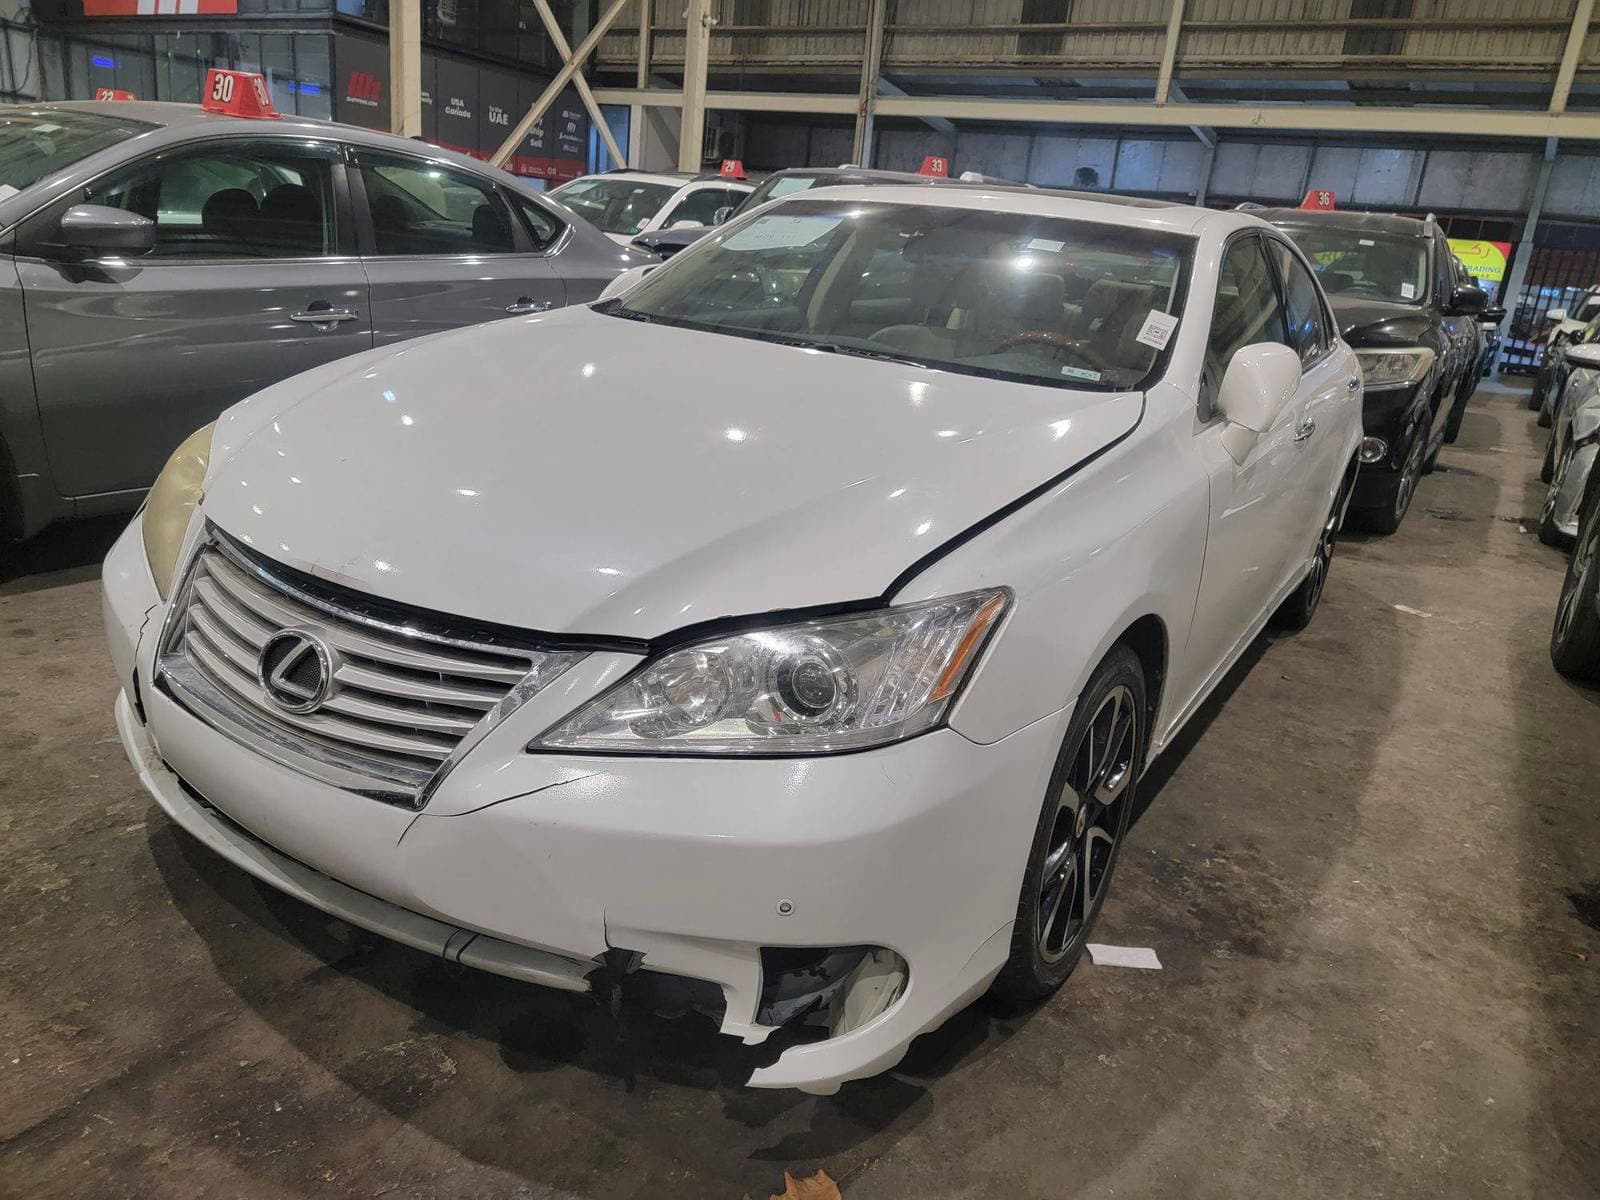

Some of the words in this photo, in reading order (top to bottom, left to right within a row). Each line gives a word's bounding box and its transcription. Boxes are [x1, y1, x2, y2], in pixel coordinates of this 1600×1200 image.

[212, 73, 234, 103] 30
[450, 97, 465, 107] USA
[488, 111, 509, 125] UAE
[725, 161, 735, 172] 29
[931, 159, 942, 172] 33
[1319, 191, 1330, 206] 36
